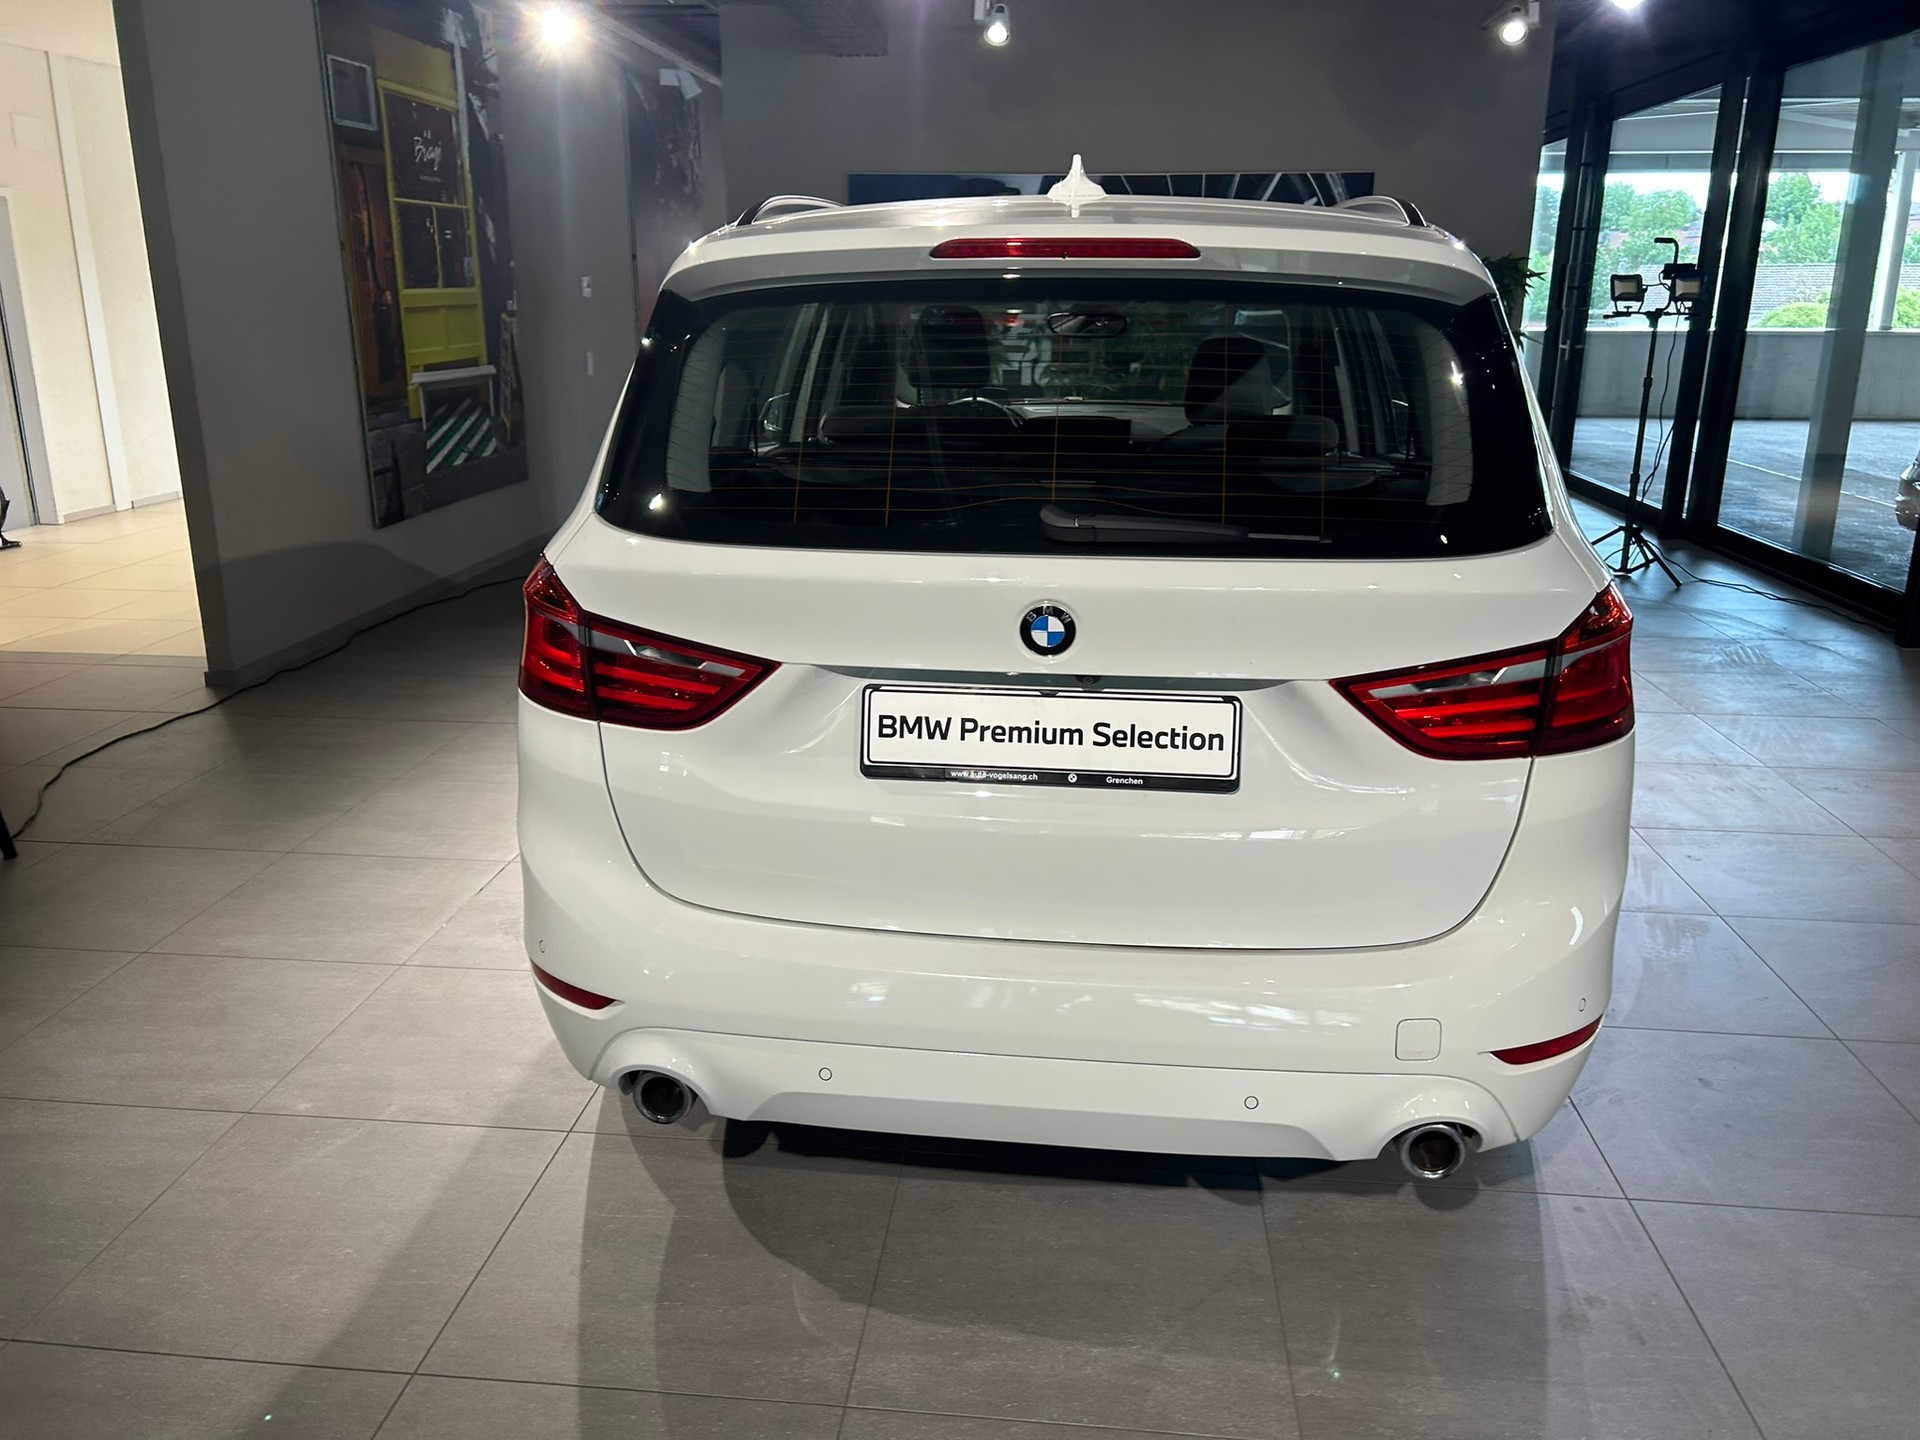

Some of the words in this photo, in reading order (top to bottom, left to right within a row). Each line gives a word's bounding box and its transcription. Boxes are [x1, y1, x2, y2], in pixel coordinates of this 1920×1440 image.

[1026, 605, 1071, 624] BMW
[878, 714, 952, 741] BMW
[960, 717, 1084, 746] Premium
[1092, 722, 1225, 751] Selection
[950, 770, 1039, 781] www.auto-vogelsang.ch
[1105, 776, 1144, 785] Grenchen
